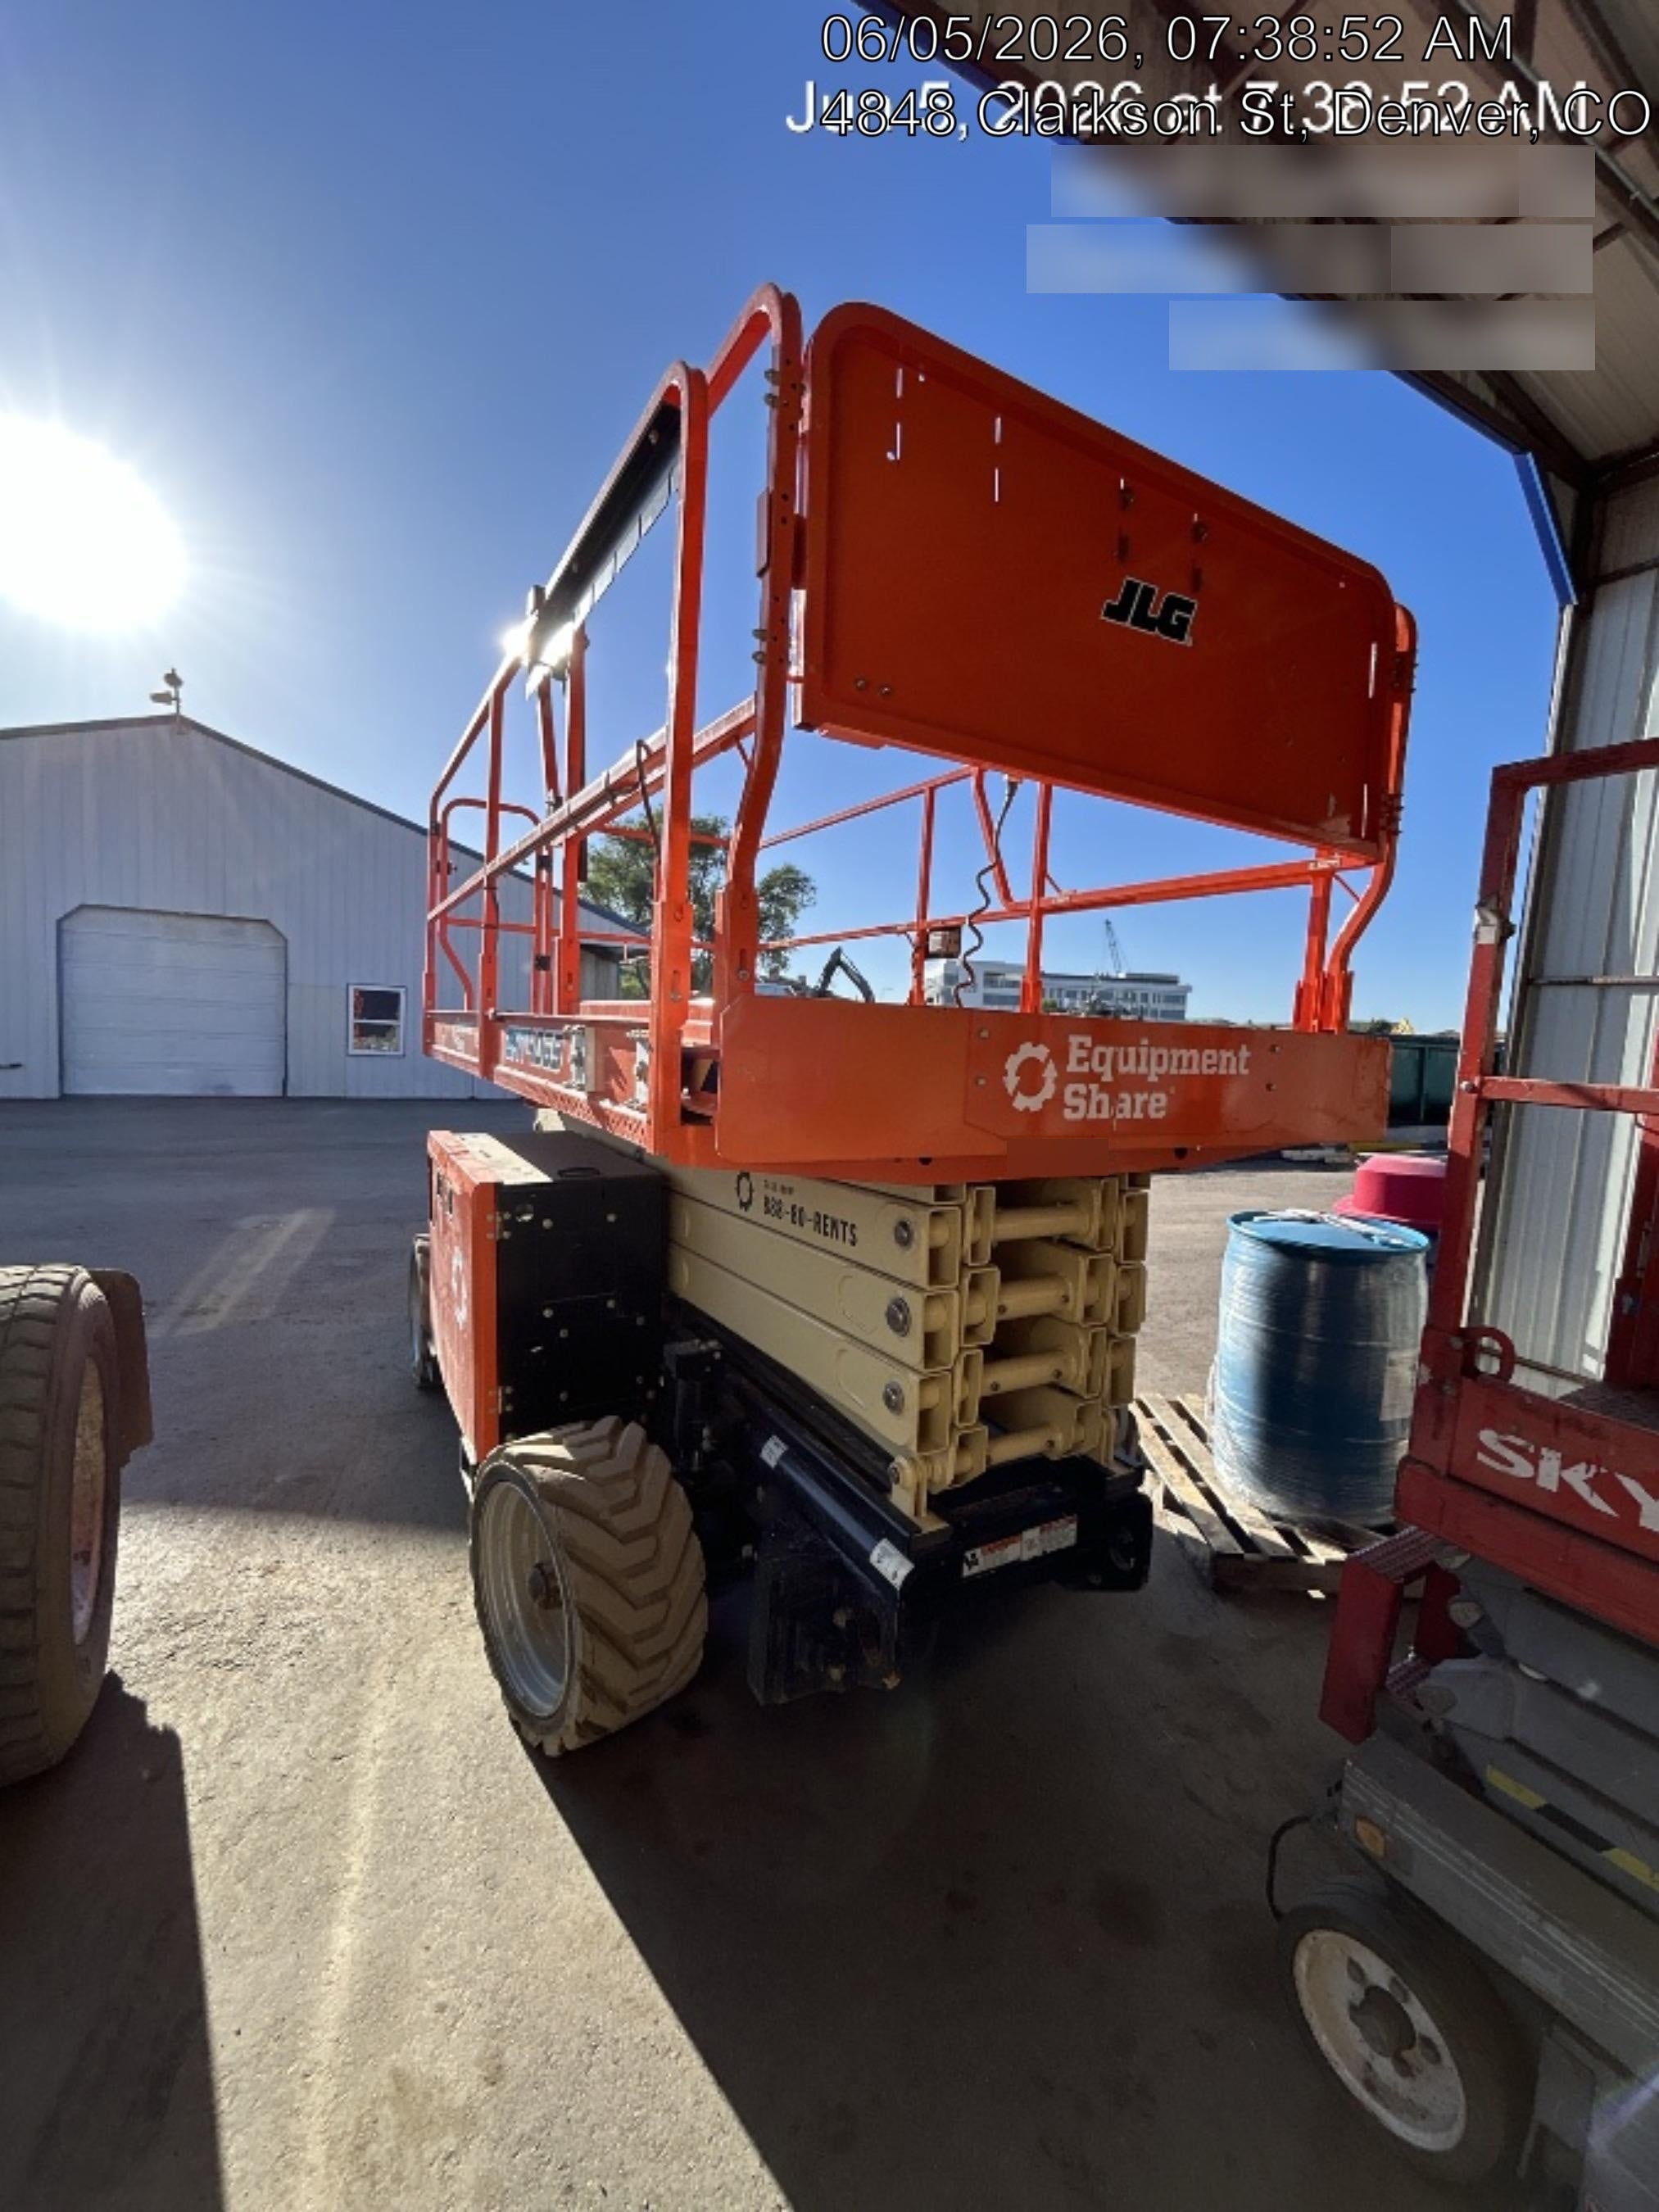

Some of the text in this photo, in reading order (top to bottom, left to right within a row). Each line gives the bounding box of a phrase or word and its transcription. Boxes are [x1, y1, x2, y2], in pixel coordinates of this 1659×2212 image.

[1101, 576, 1197, 646] JLG
[1066, 1034, 1251, 1081] Equipment
[1063, 1083, 1167, 1120] Share
